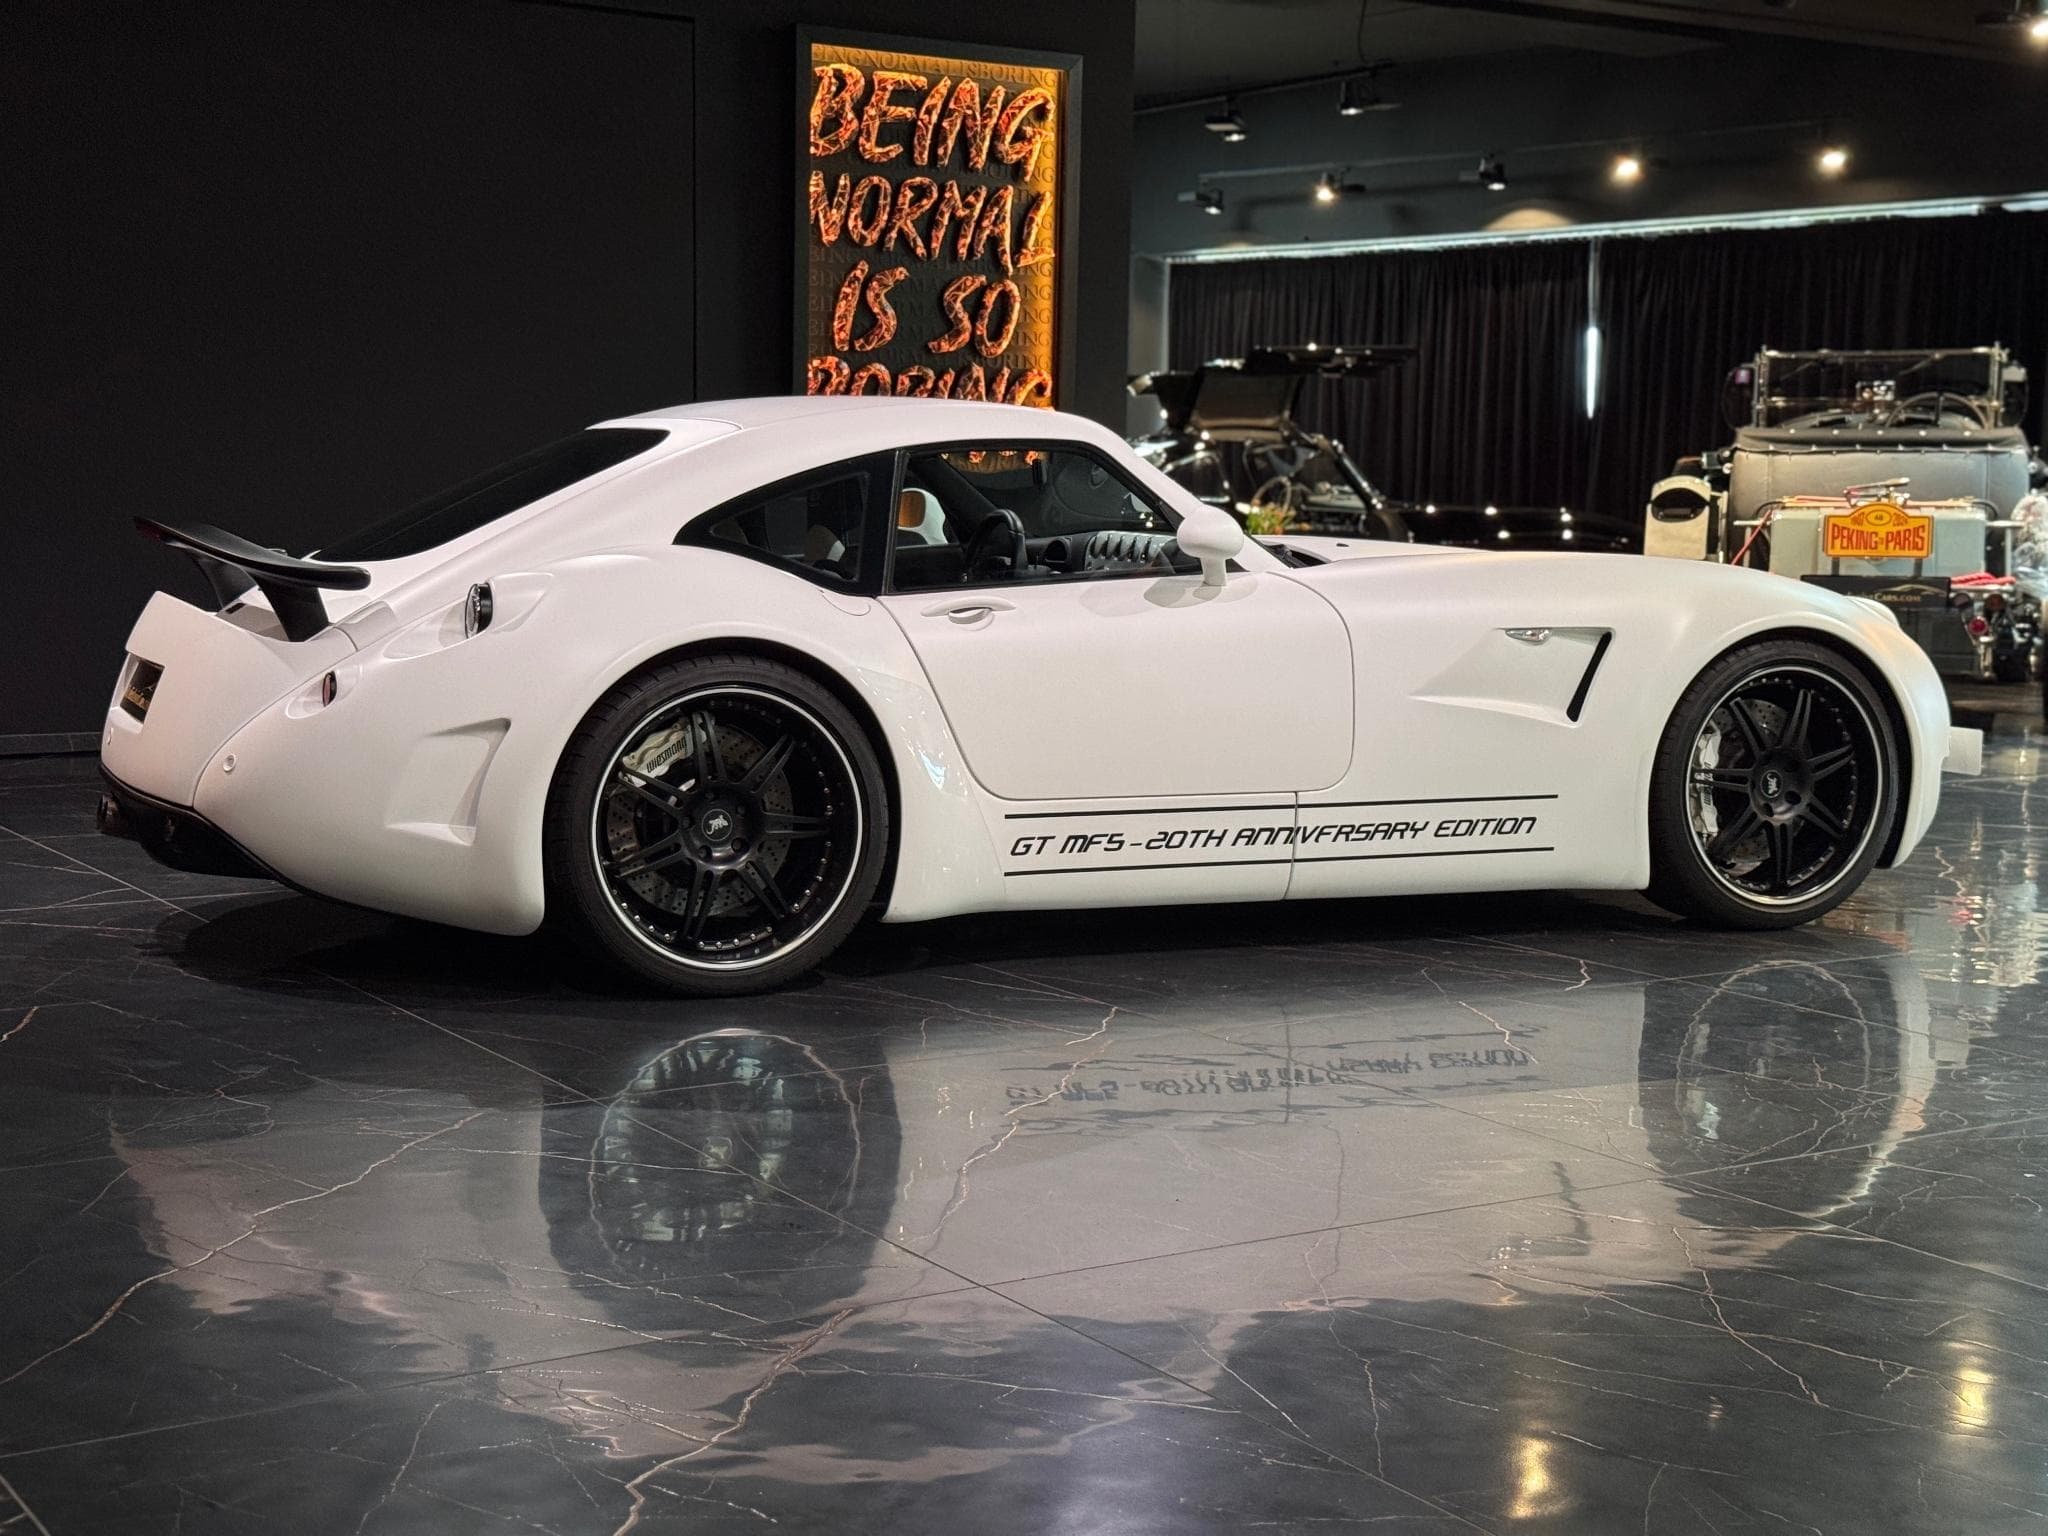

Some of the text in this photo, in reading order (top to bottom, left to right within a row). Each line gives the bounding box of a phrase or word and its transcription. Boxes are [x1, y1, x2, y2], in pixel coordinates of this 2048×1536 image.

[810, 63, 1056, 182] BEING
[810, 170, 1055, 275] NORMAL
[833, 259, 909, 351] IS
[927, 274, 1021, 358] SO
[1830, 522, 1878, 551] PEKING
[1885, 524, 1926, 551] PARIS
[1011, 836, 1055, 856] GT
[1433, 816, 1537, 838] EDITION
